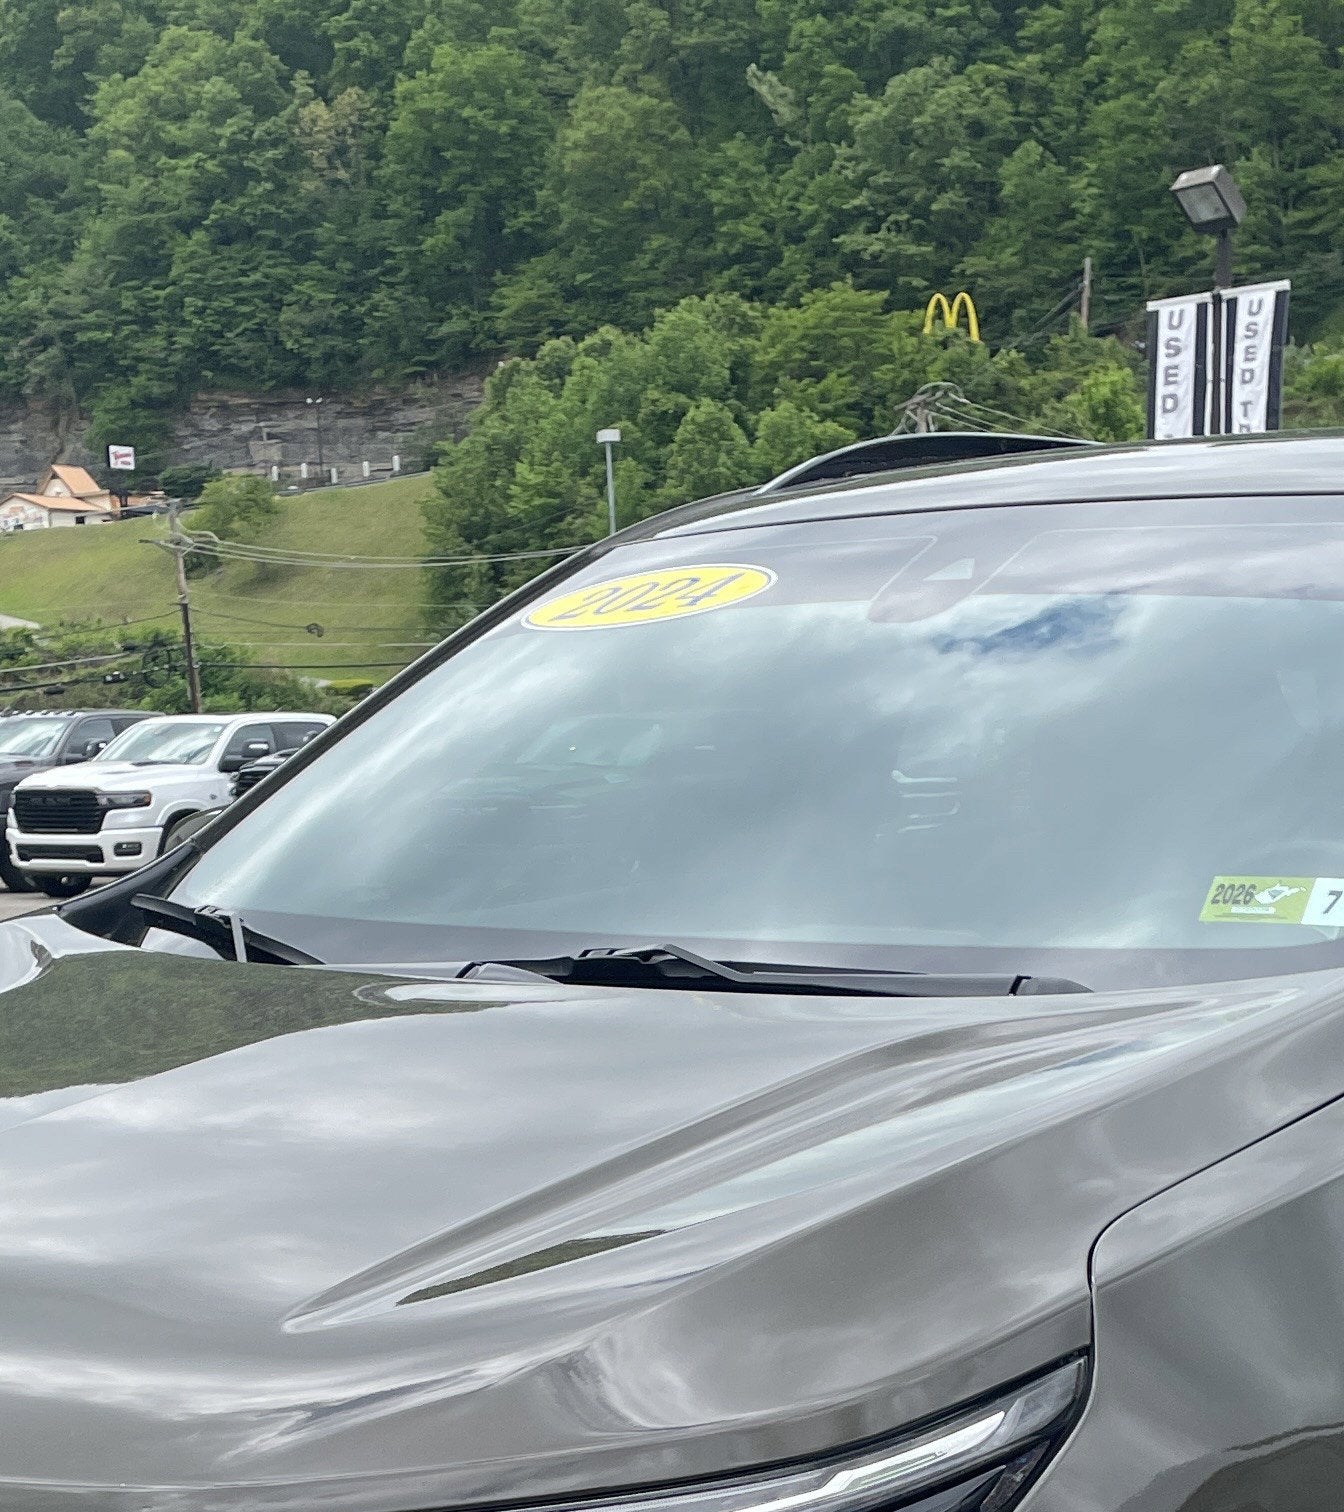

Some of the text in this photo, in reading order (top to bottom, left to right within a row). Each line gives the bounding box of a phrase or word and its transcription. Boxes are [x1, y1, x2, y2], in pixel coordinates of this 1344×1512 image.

[1162, 309, 1185, 414] USED
[1240, 299, 1264, 386] USED
[547, 572, 746, 622] 2024
[1211, 883, 1343, 914] 2026 7
